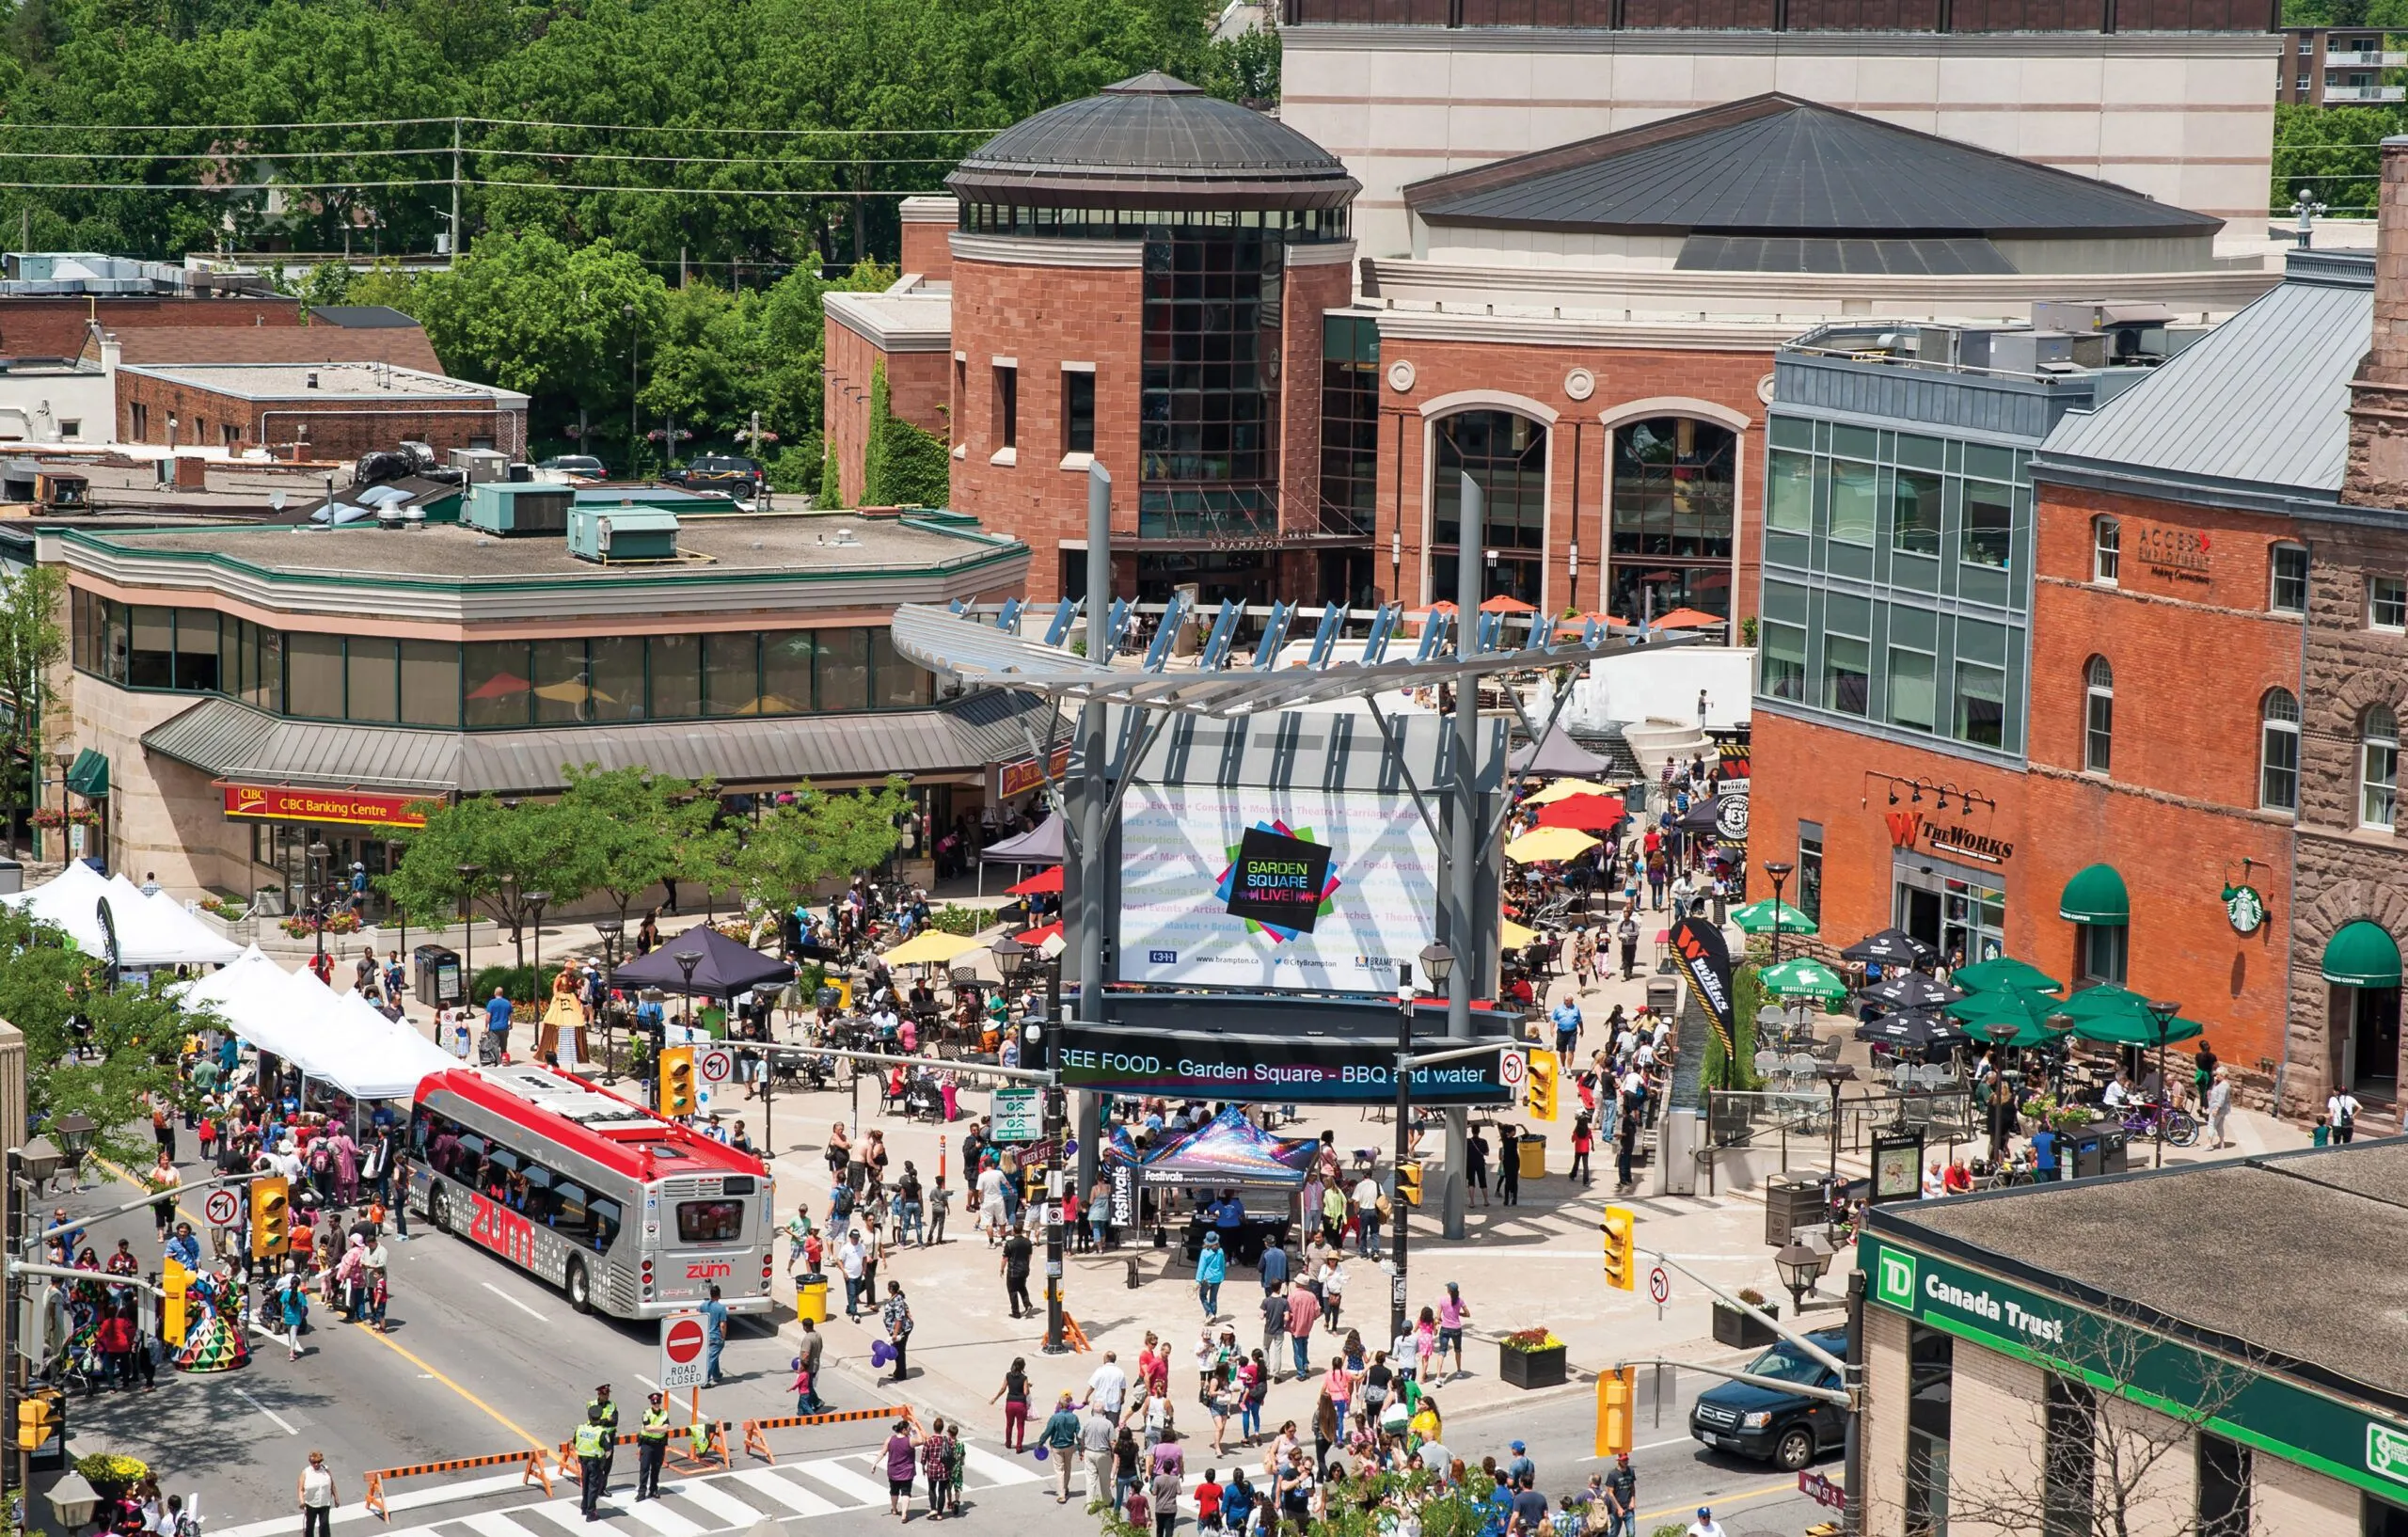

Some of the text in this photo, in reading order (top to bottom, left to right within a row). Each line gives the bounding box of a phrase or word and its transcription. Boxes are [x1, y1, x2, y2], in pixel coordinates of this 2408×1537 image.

[1211, 541, 1283, 550] BRAMPTON
[2138, 547, 2210, 565] EMPLOYMENT
[240, 788, 265, 800] CIBC
[279, 798, 388, 816] CIBC Banking Centre
[1151, 801, 1184, 811] Events
[1195, 801, 1239, 813] Concerts
[1249, 804, 1287, 815] Movies
[1297, 805, 1335, 816] Theatre
[1346, 807, 1389, 819] Carriage
[1725, 808, 1749, 825] BEST
[1160, 852, 1196, 863] Market
[1364, 860, 1388, 870] Food
[1392, 861, 1435, 872] Festivals
[1247, 861, 1307, 875] GARDEN
[1247, 875, 1307, 889] SQUARE
[1260, 889, 1294, 901] LIVE!
[1193, 905, 1226, 915] Artists
[1386, 912, 1423, 922] Theatre
[1165, 921, 1200, 931] Market
[1196, 954, 1259, 965] www.brampton.ca
[1283, 958, 1337, 968] @CityBrampton
[1694, 958, 1729, 1010] WORKS
[1781, 985, 1814, 994] MOOSEHEAD
[1046, 1047, 1096, 1069] REE
[1101, 1053, 1160, 1074] FOOD
[1179, 1059, 1247, 1080] Garden
[1254, 1063, 1323, 1085] Square
[1342, 1066, 1387, 1084] BBQ
[1434, 1067, 1486, 1083] water
[1882, 1137, 1913, 1146] INFORMATION
[1021, 1146, 1052, 1166] QUEEN ST E
[1145, 1170, 1183, 1182] Festivals
[1111, 1165, 1129, 1227] Festivals
[1882, 1258, 1912, 1298] TD
[1925, 1274, 2064, 1344] Canada Trust
[671, 1364, 697, 1375] ROAD
[665, 1373, 702, 1386] CLOSED
[1805, 1479, 1838, 1505] MAIN ST S
